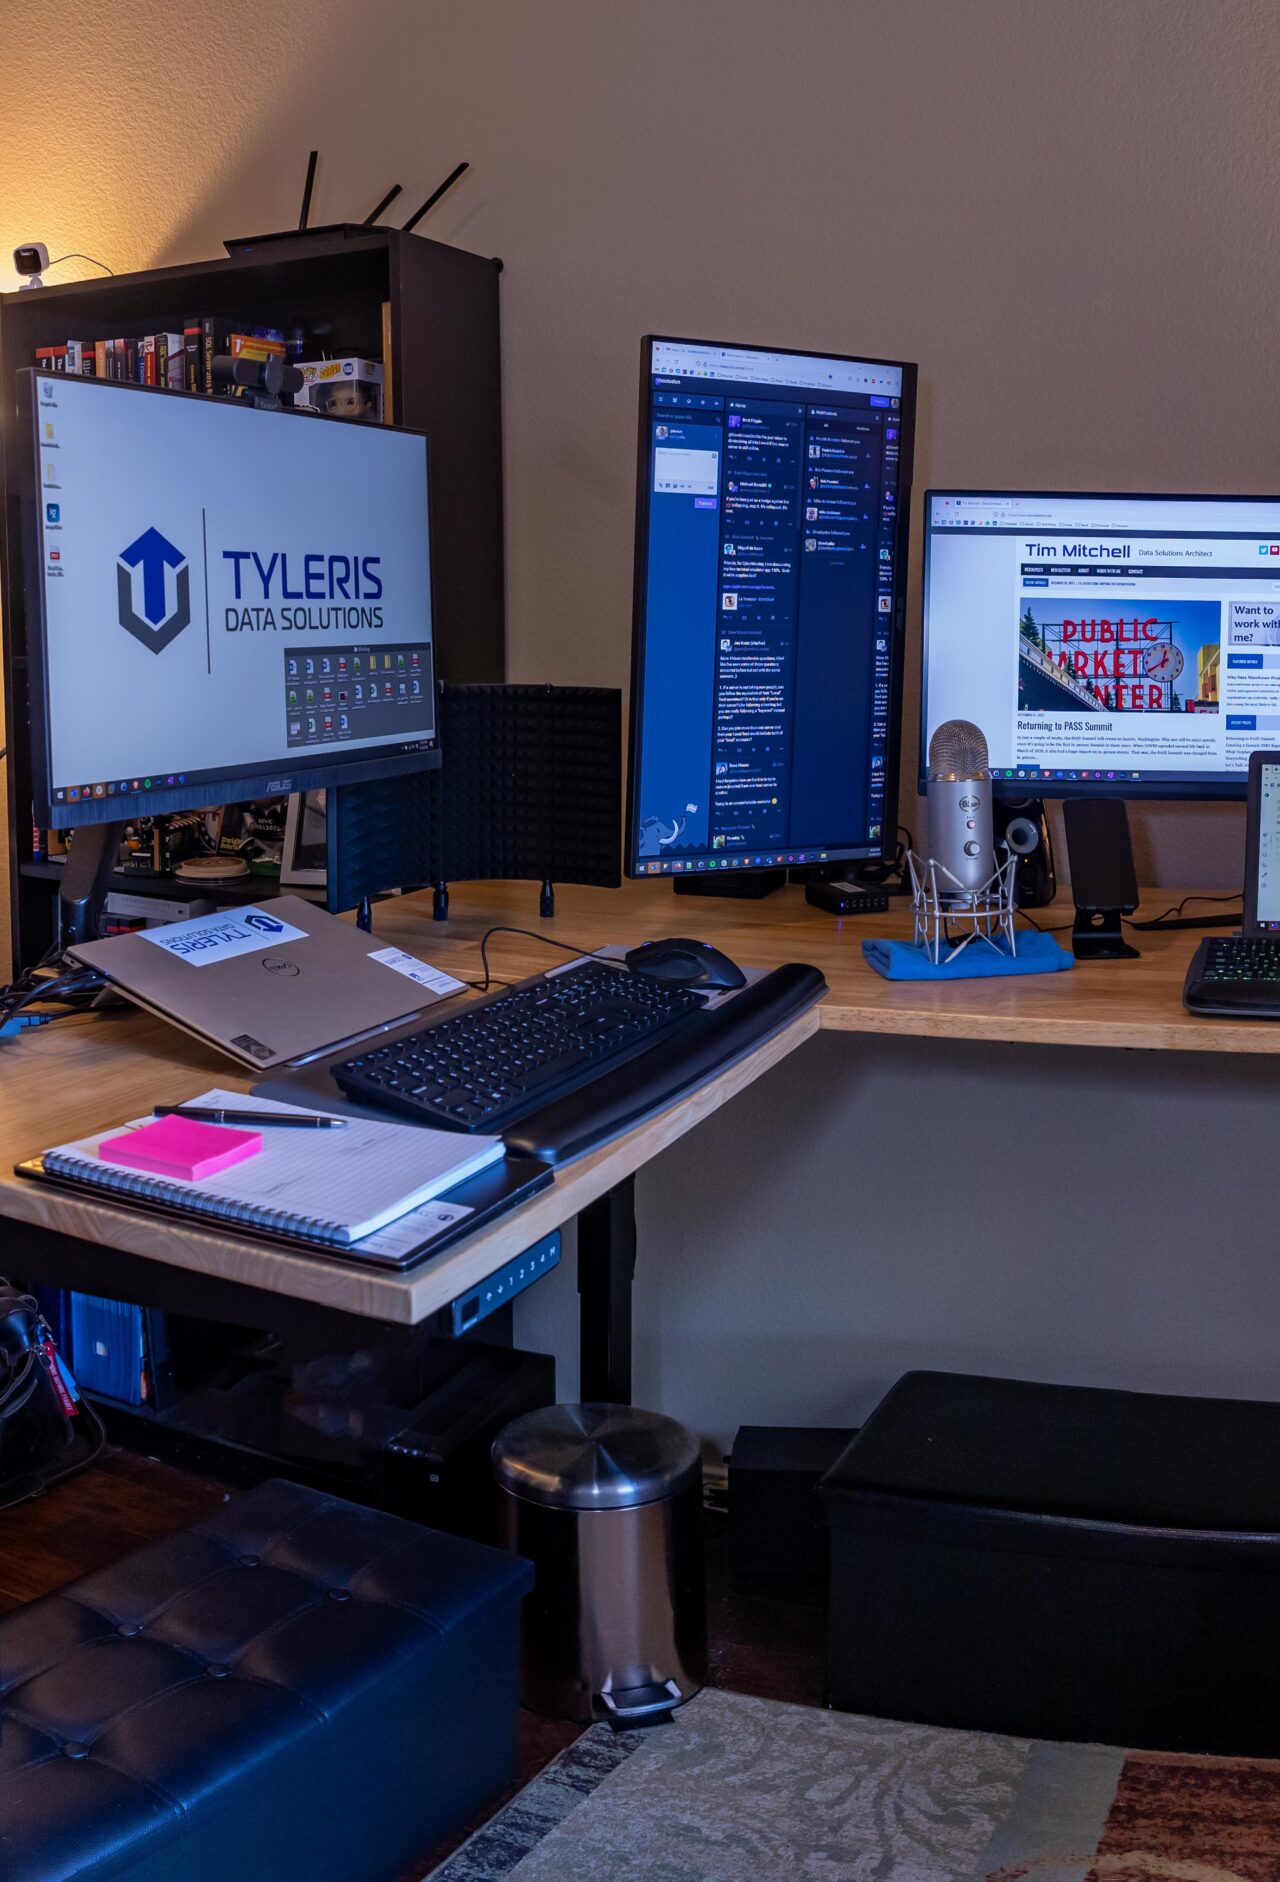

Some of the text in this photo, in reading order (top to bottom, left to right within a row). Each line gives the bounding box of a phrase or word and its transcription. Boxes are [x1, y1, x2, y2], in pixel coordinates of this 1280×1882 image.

[205, 350, 213, 370] Server
[1025, 544, 1056, 557] Tim
[1063, 544, 1130, 558] Mitchell
[222, 550, 383, 601] TYLERIS
[225, 606, 384, 633] DATA SOLUTIONS
[1235, 606, 1261, 614] Want
[1062, 618, 1158, 643] PUBLIC
[1234, 620, 1260, 628] work
[1047, 650, 1144, 678] ARKET
[1084, 684, 1163, 710] NTER
[1018, 721, 1112, 731] Returning to PASS Summit
[159, 927, 213, 946] SOLUTIONS
[170, 929, 252, 955] TYLERIS
